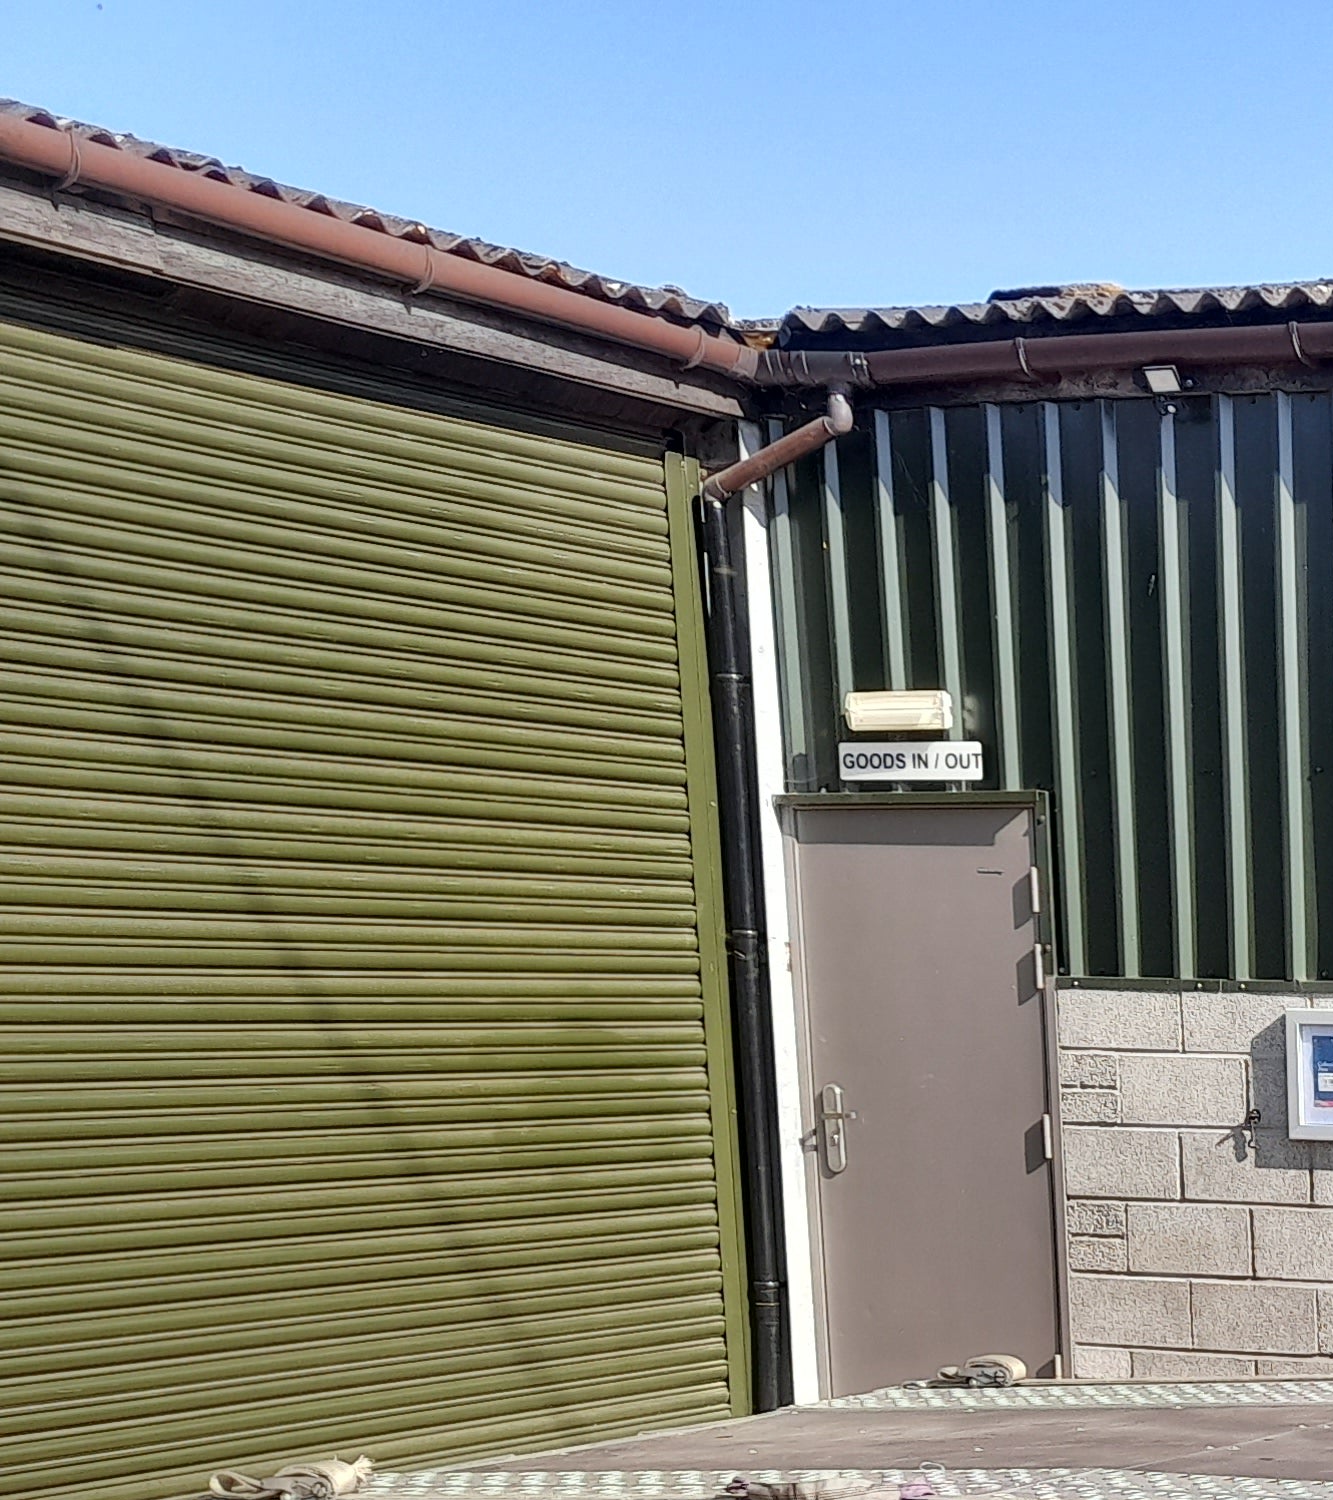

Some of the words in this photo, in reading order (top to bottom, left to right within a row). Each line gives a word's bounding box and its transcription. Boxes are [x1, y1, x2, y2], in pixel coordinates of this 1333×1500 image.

[842, 753, 906, 770] GOODS
[912, 753, 928, 769] IN
[934, 753, 940, 769] /
[945, 753, 982, 769] OUT
